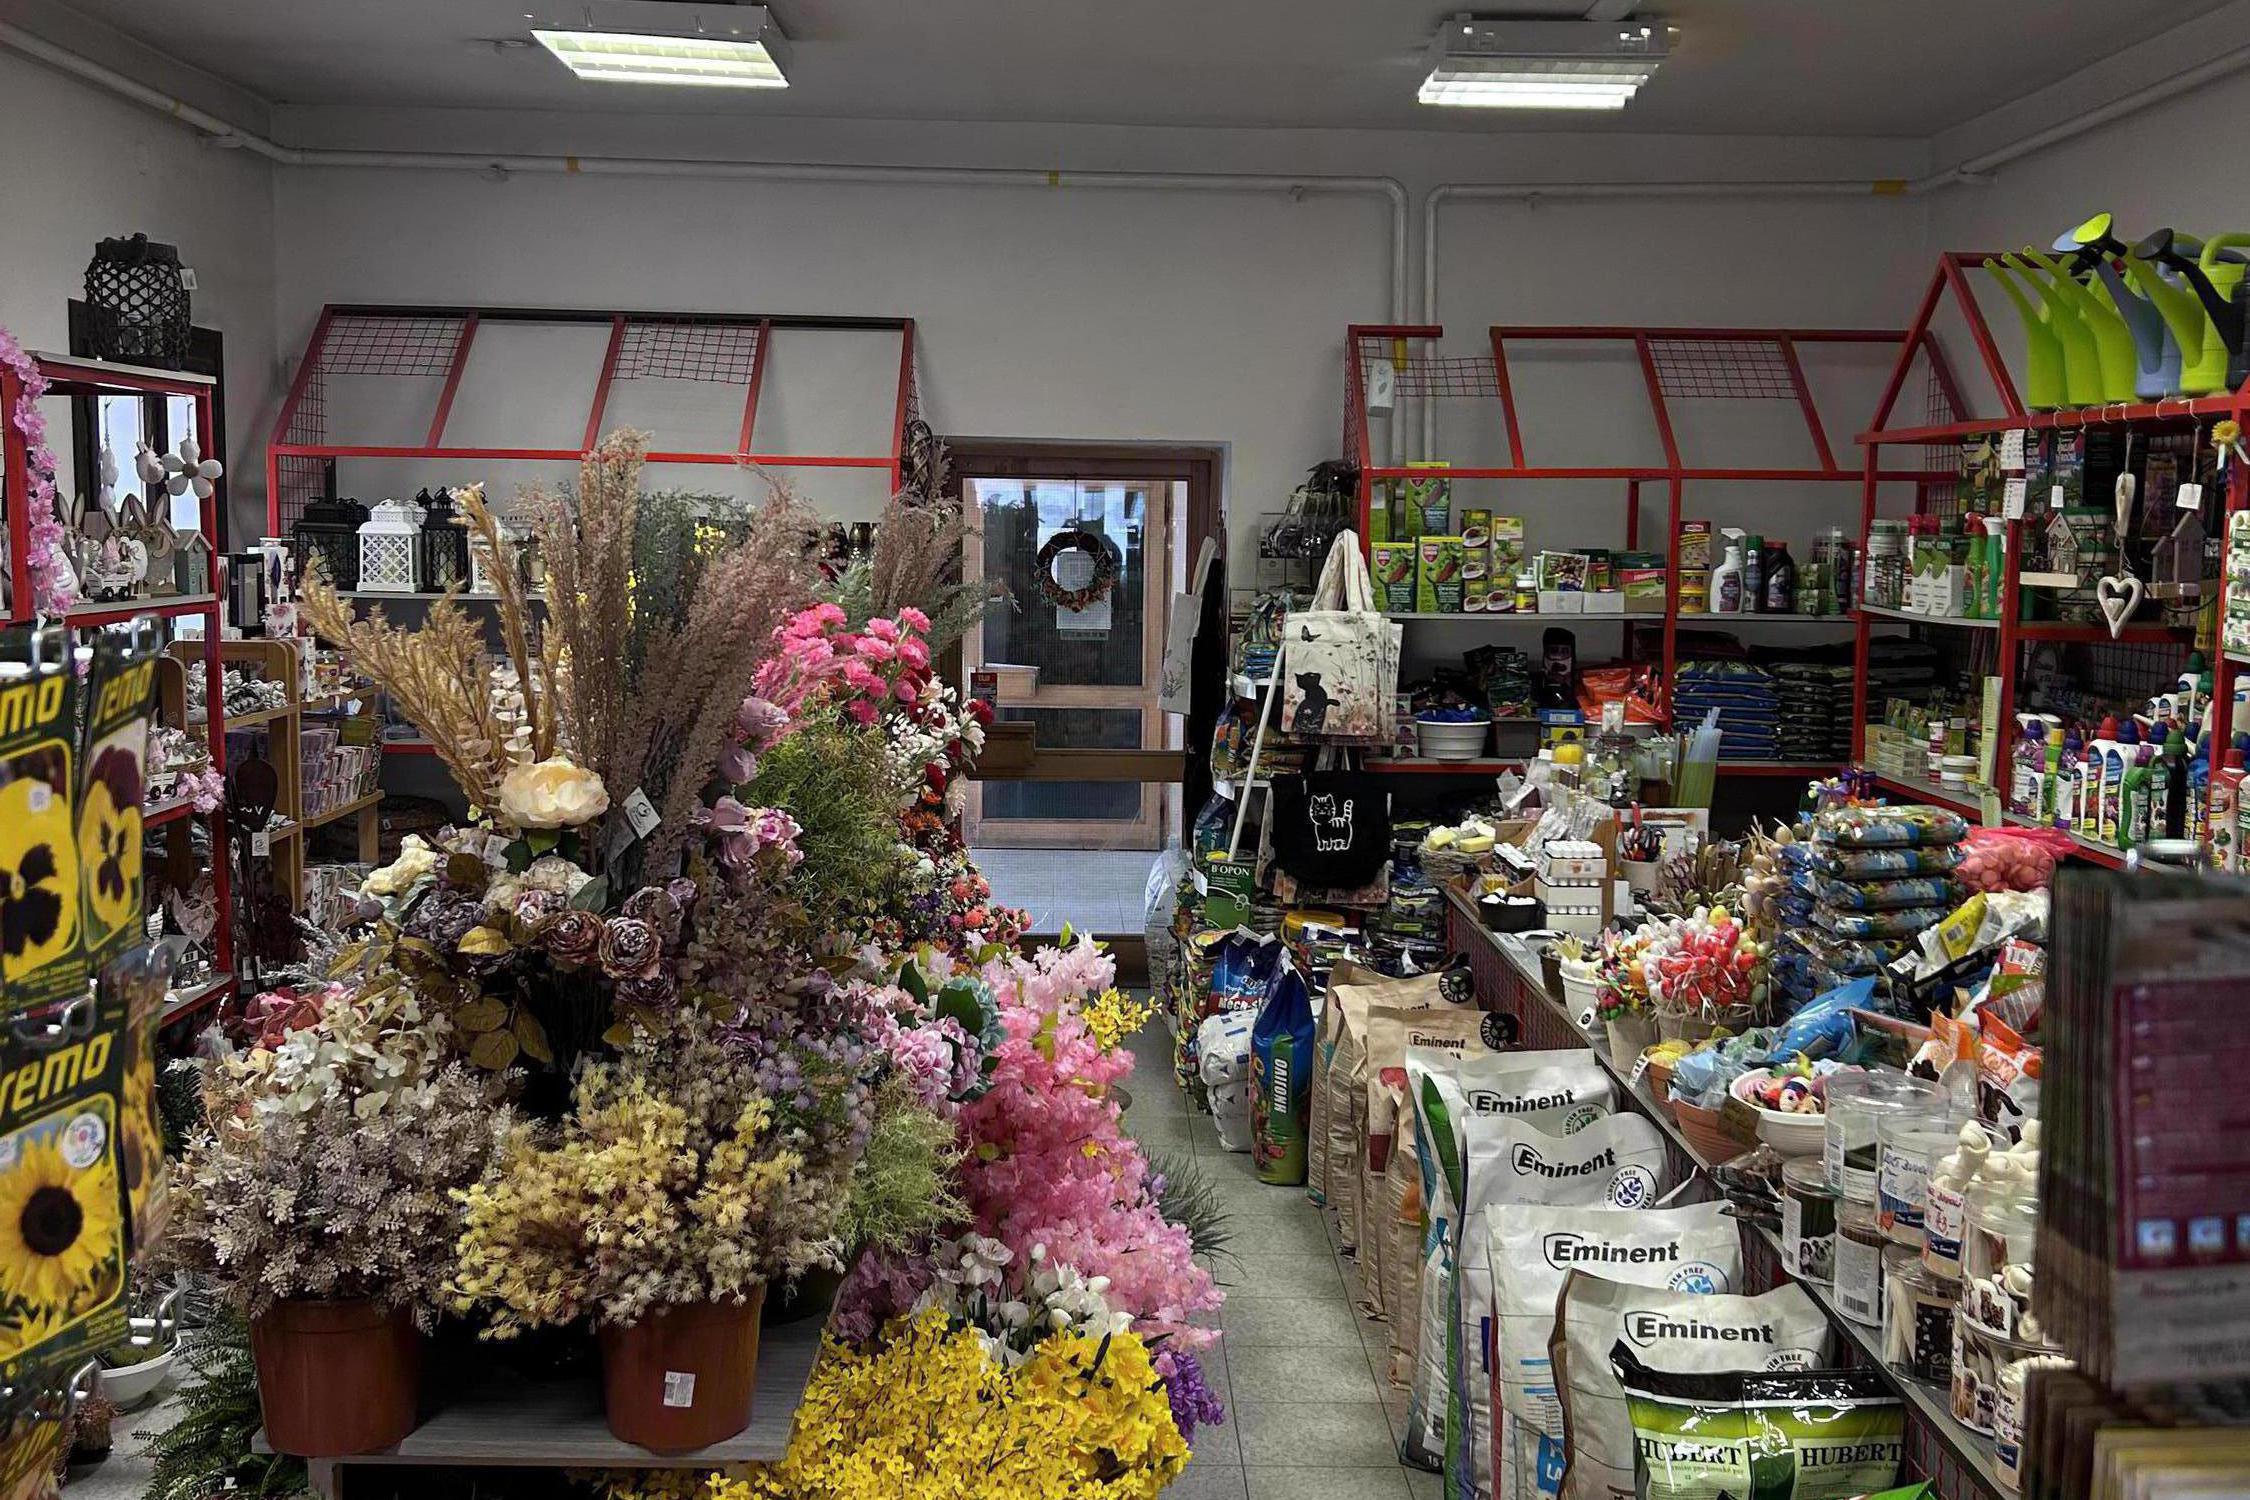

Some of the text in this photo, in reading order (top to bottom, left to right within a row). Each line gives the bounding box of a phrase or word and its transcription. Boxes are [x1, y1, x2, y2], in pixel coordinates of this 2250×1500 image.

[1413, 1034, 1466, 1049] Eminent
[1475, 1089, 1576, 1114] Eminent
[1517, 1147, 1616, 1178] Eminent
[1553, 1239, 1680, 1264] Eminent
[1683, 1267, 1704, 1275] FREE
[1636, 1316, 1774, 1344] Eminent
[1780, 1354, 1802, 1362] FREE
[1637, 1438, 1742, 1466] HUBERT
[1801, 1443, 1904, 1467] HUBERT
